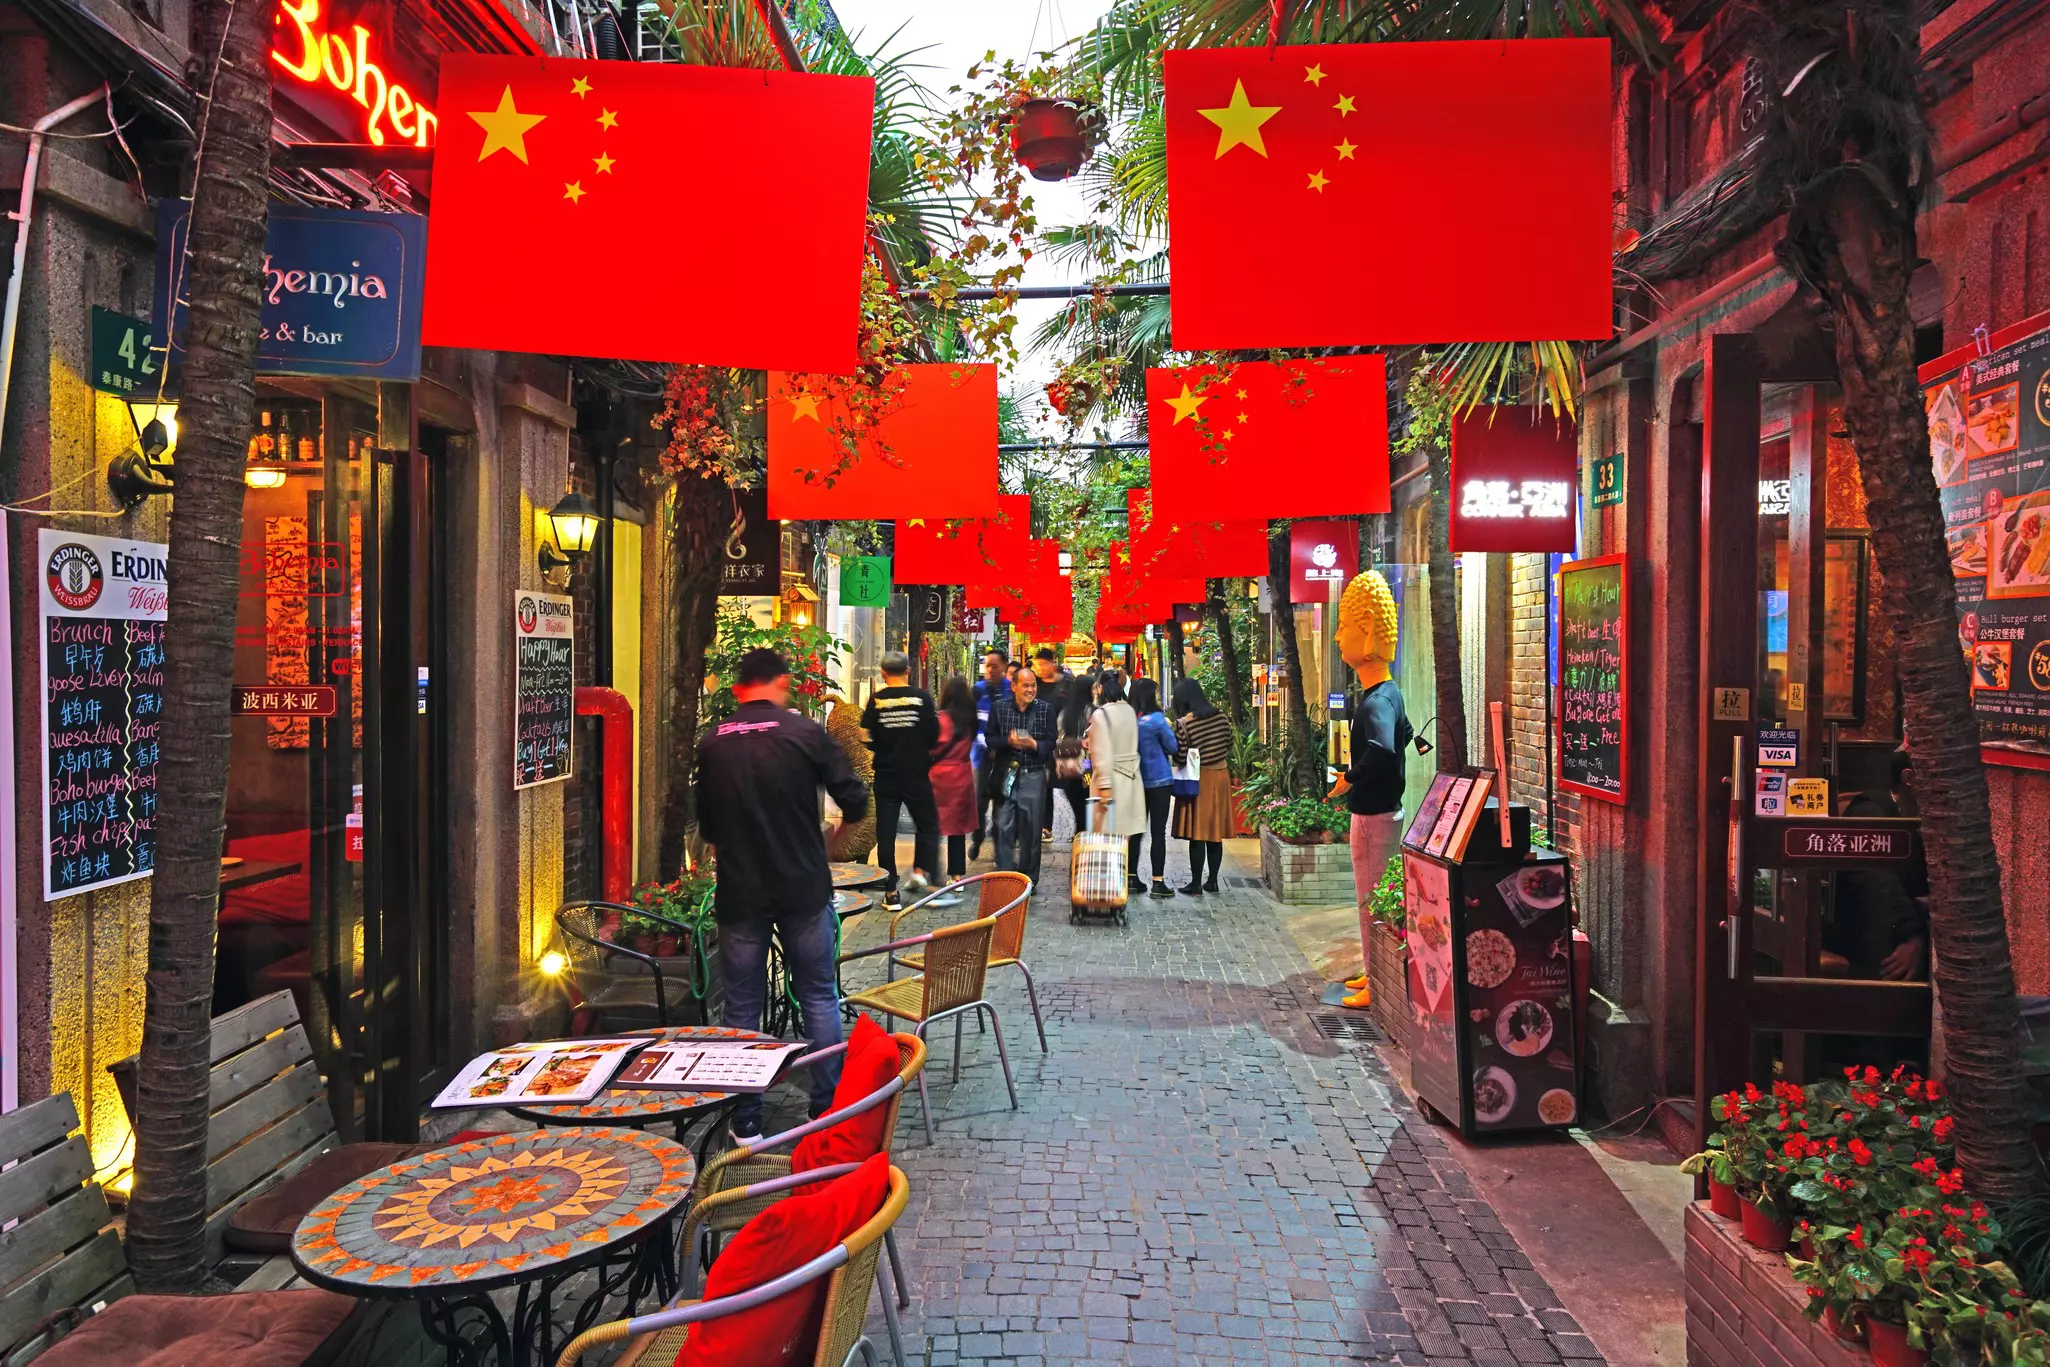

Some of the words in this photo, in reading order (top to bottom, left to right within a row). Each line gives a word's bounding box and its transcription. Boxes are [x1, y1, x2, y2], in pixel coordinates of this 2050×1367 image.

[263, 254, 388, 308] hemia
[303, 324, 343, 345] bar
[1963, 366, 1969, 381] A
[1599, 462, 1614, 490] 33
[1989, 490, 1997, 506] B
[51, 546, 100, 575] ERDINGER
[111, 550, 168, 582] ERDIN
[539, 599, 572, 618] ERDINGER
[1966, 613, 1975, 628] C
[1981, 614, 1997, 624] Bull
[2001, 614, 2029, 625] burger
[2033, 613, 2048, 623] set
[50, 616, 113, 645] Brunch
[520, 637, 551, 667] Happy
[47, 673, 86, 703] goose
[242, 691, 319, 711] 波西米亚
[1722, 690, 1741, 709] 拉
[1719, 709, 1742, 717] PULL
[1760, 730, 1796, 740] 欢迎光临
[1764, 750, 1792, 760] VISA
[1806, 833, 1892, 853] 角落亚洲
